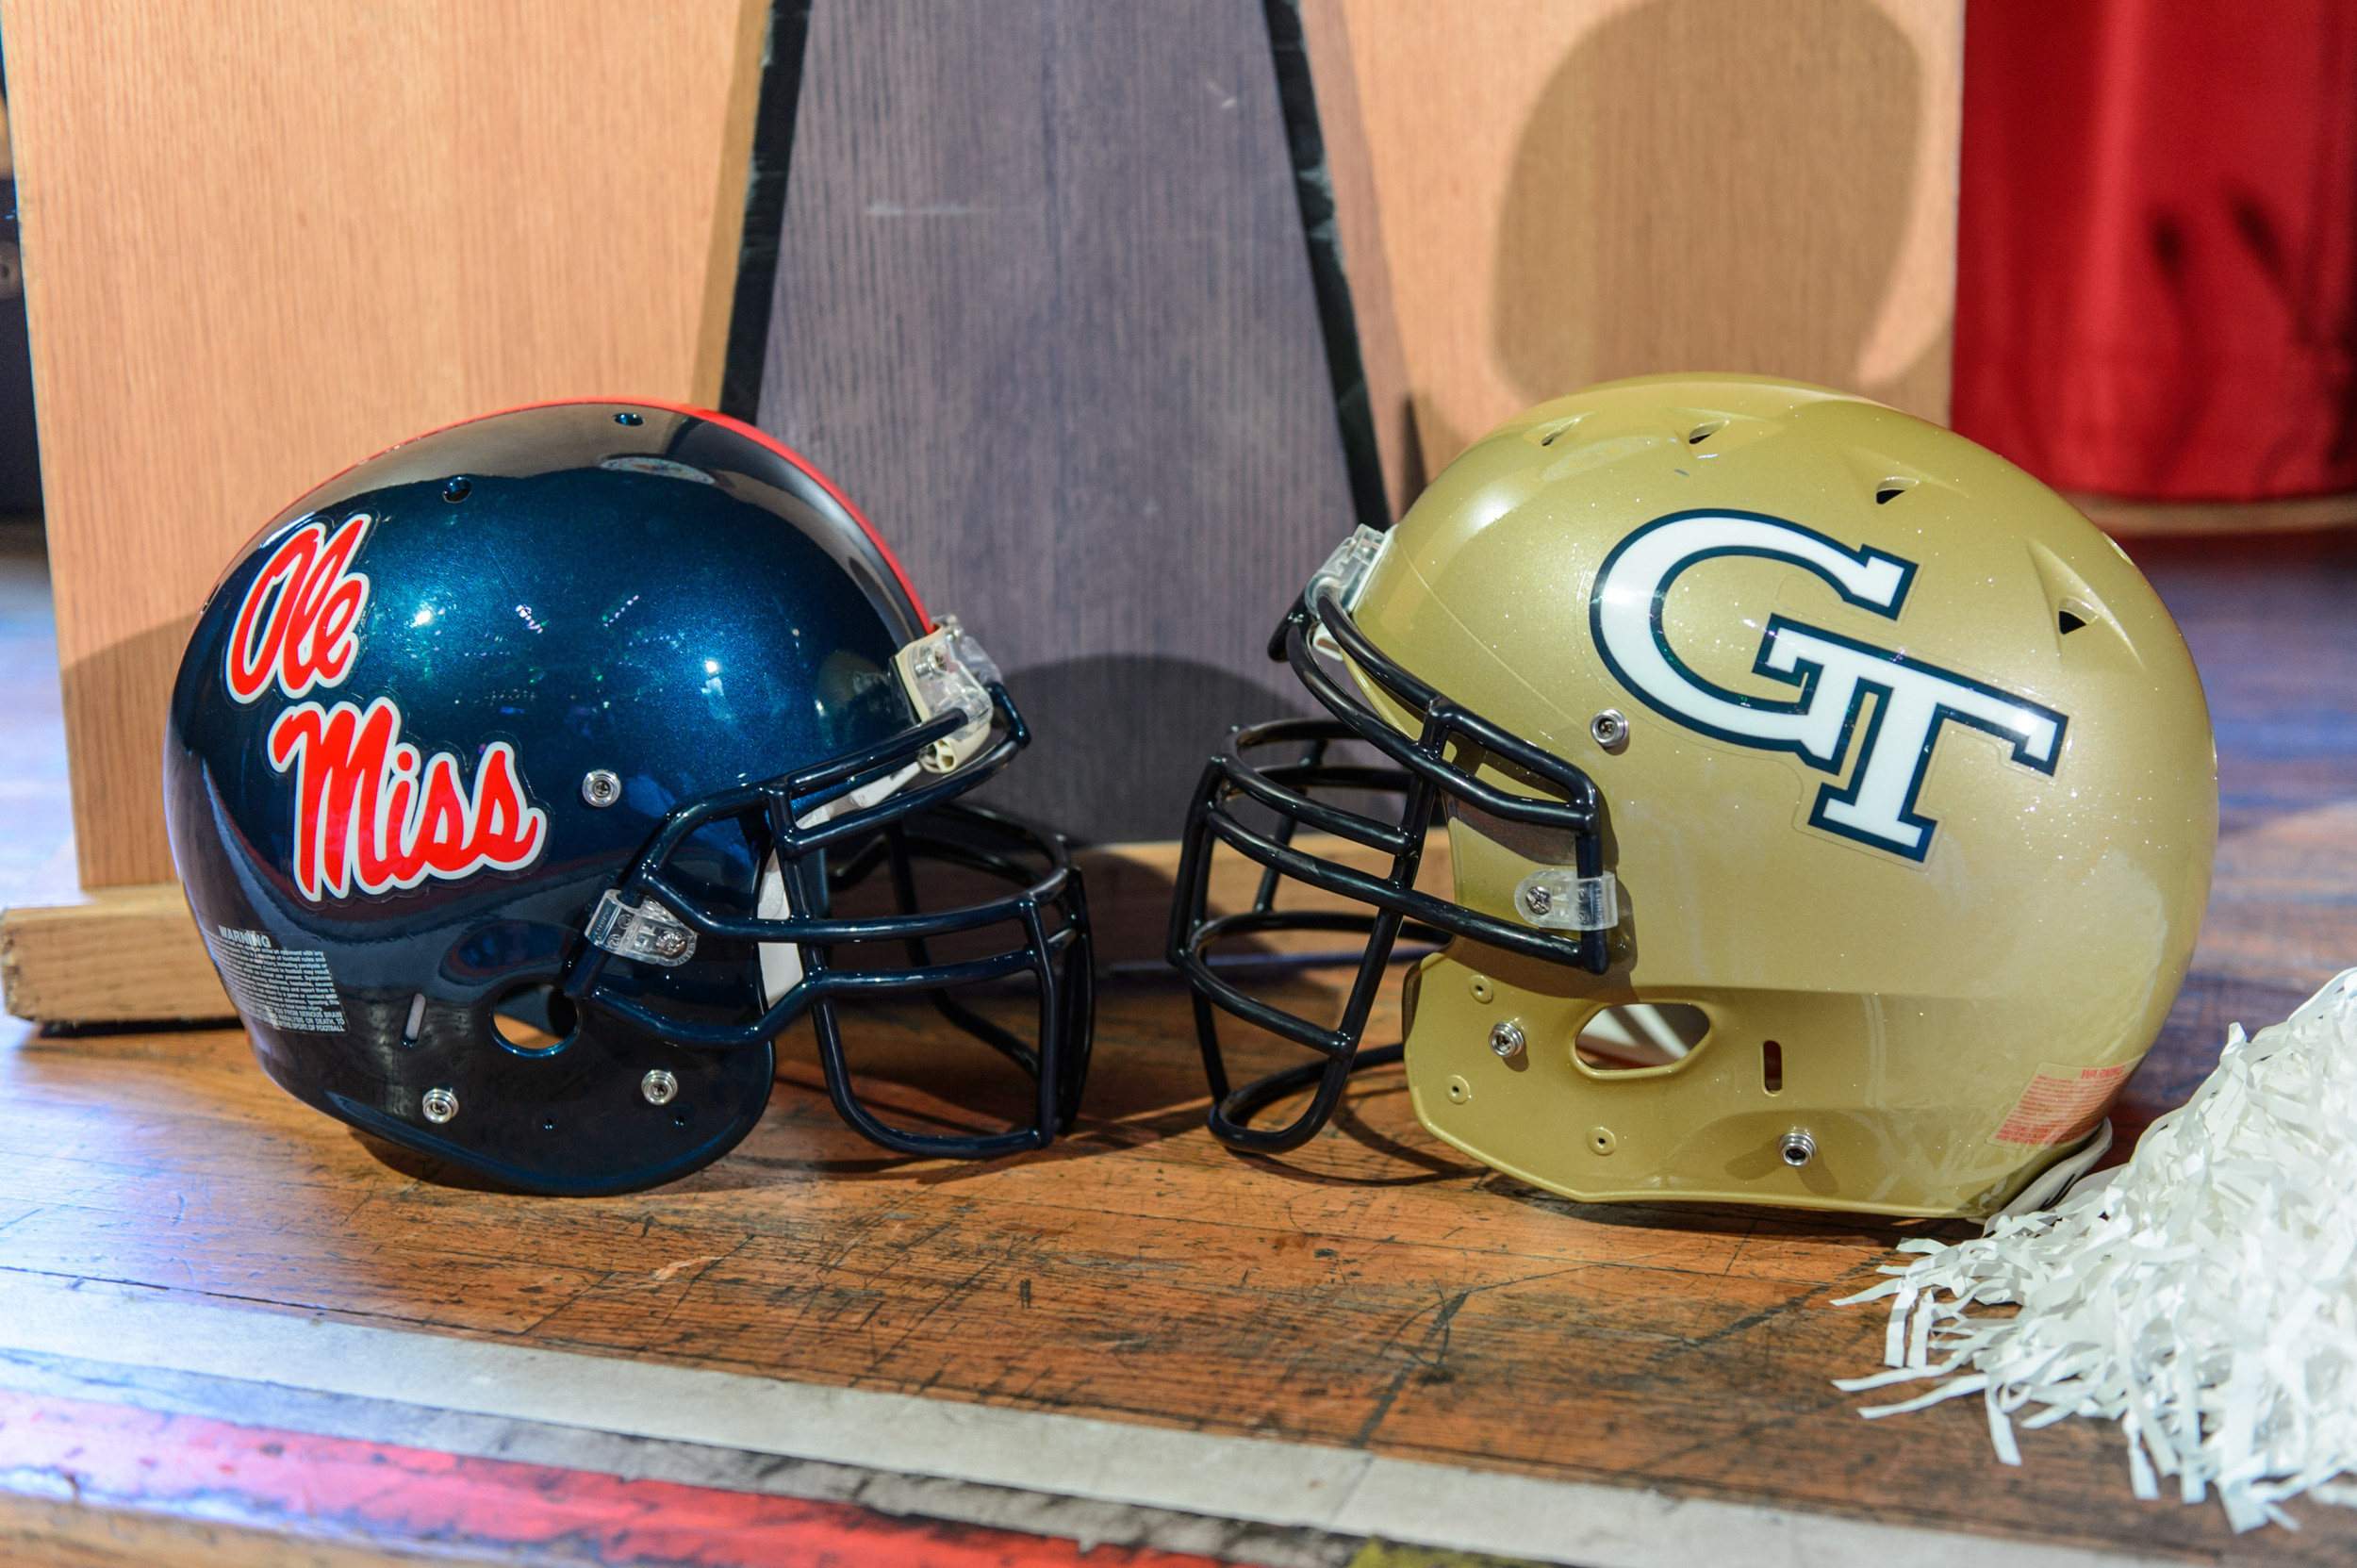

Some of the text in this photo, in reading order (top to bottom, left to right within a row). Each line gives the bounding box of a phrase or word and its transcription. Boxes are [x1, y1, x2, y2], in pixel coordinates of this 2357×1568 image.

[226, 514, 371, 703] Ole
[1590, 507, 2069, 864] GT
[268, 696, 547, 902] Miss
[218, 924, 272, 949] WARNING
[2081, 1065, 2125, 1080] WARNING
